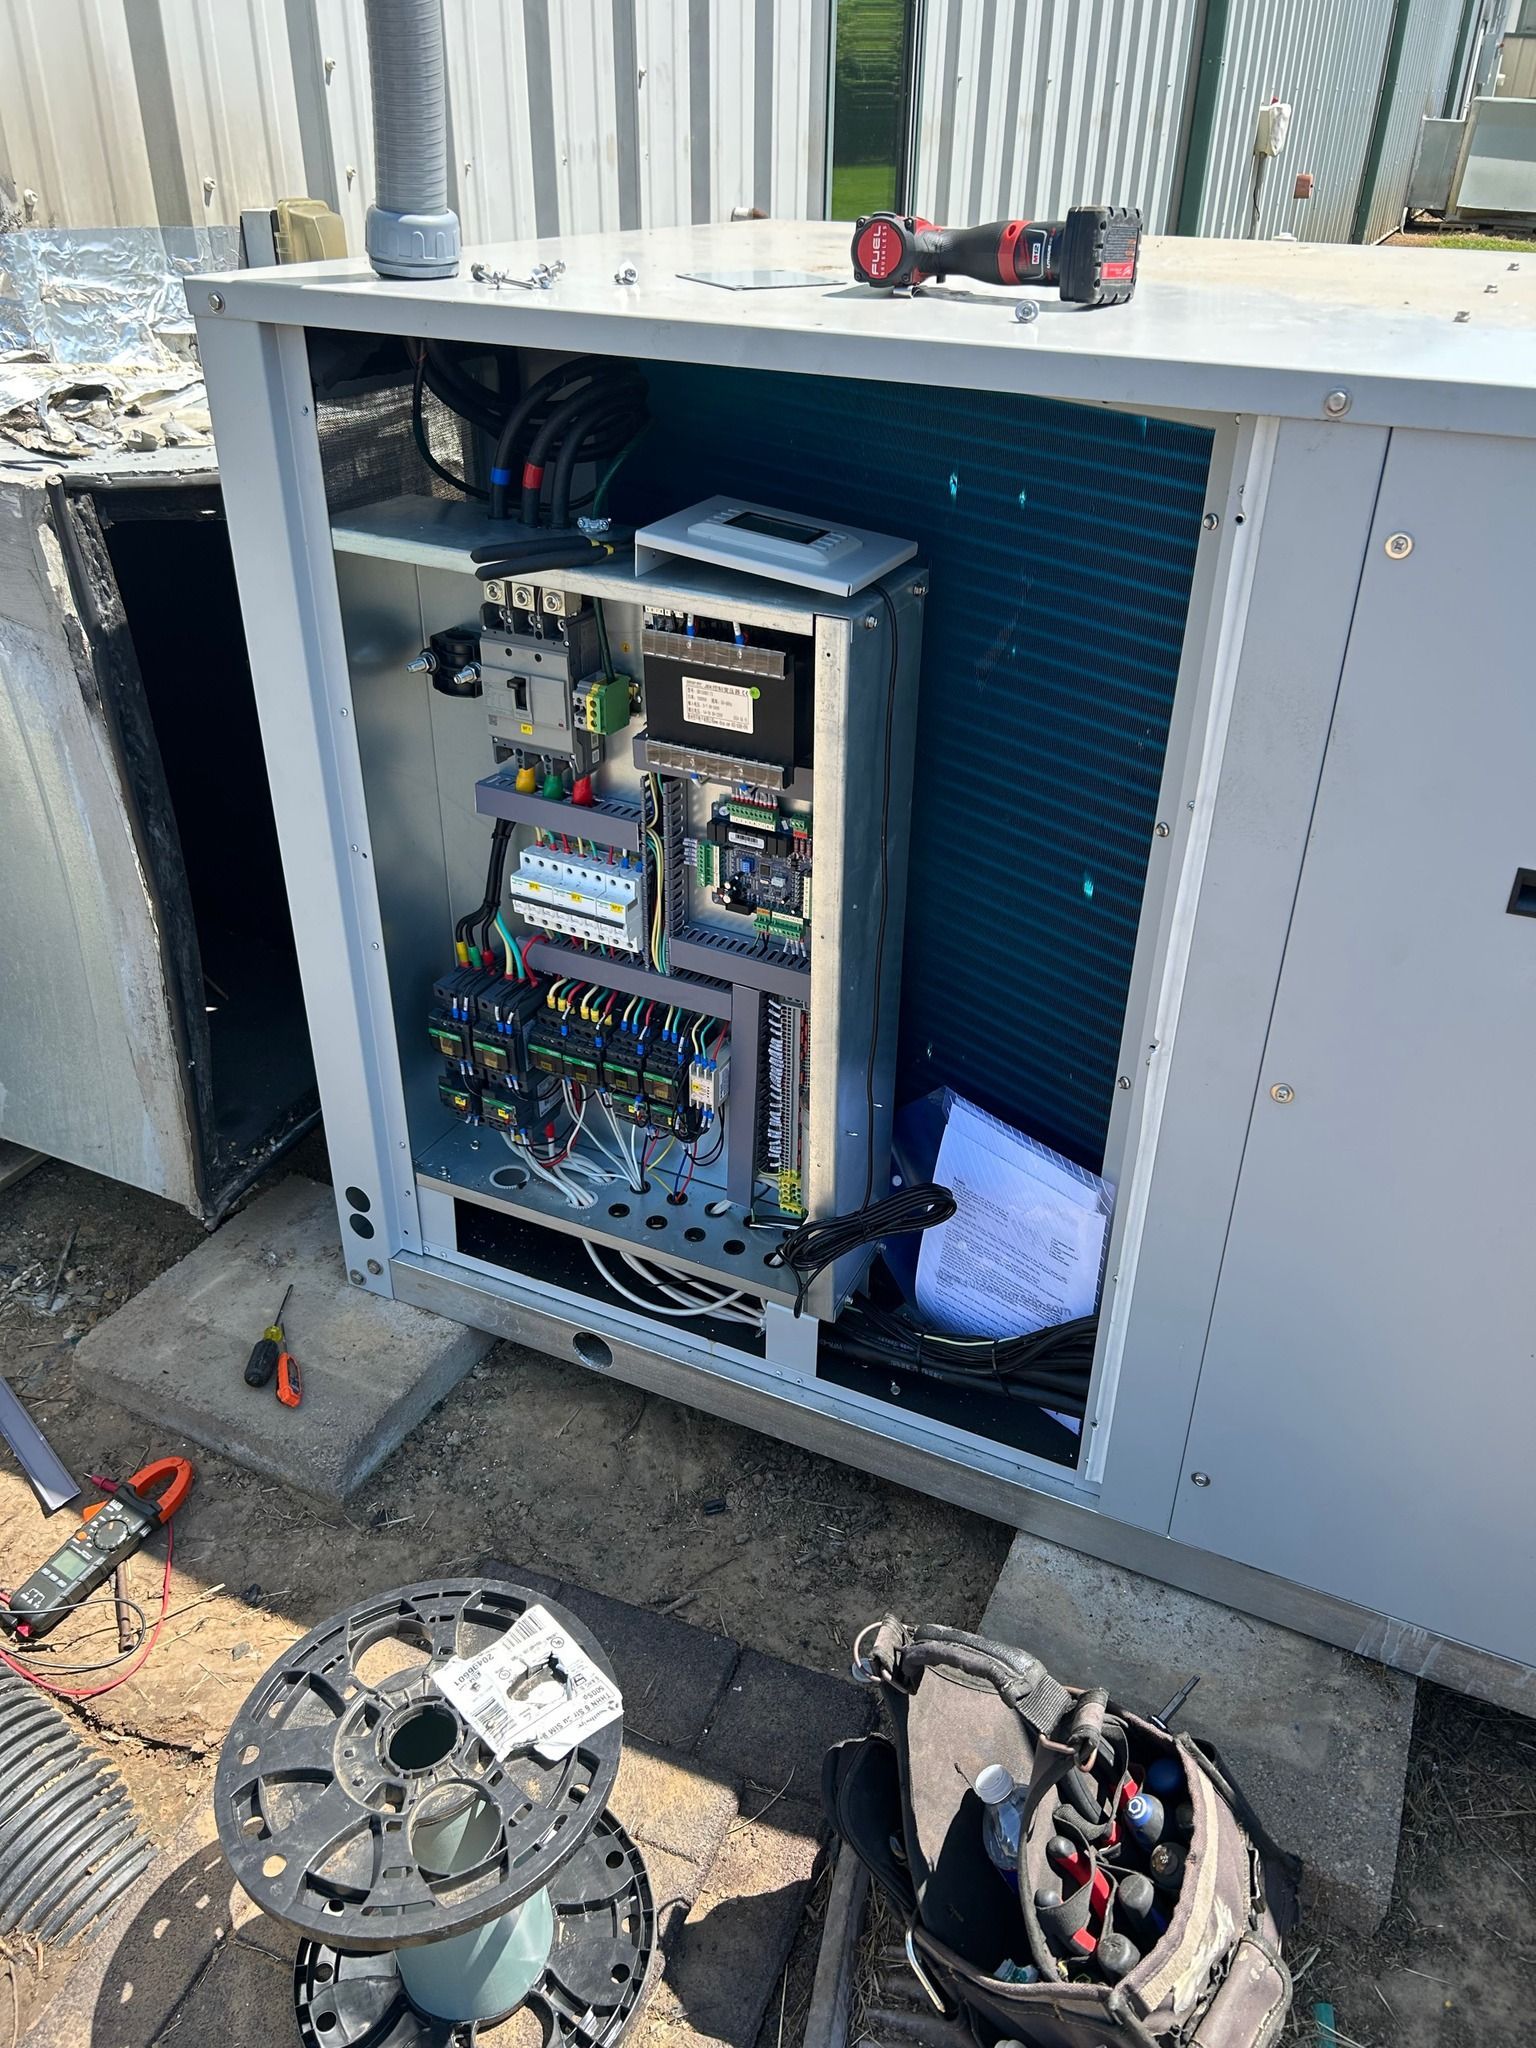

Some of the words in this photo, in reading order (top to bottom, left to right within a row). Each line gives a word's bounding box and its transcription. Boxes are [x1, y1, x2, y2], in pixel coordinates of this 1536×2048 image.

[871, 225, 882, 276] FUEL
[880, 225, 888, 277] BRUSHLESS
[1032, 243, 1041, 264] M12
[590, 1692, 611, 1708] THHN
